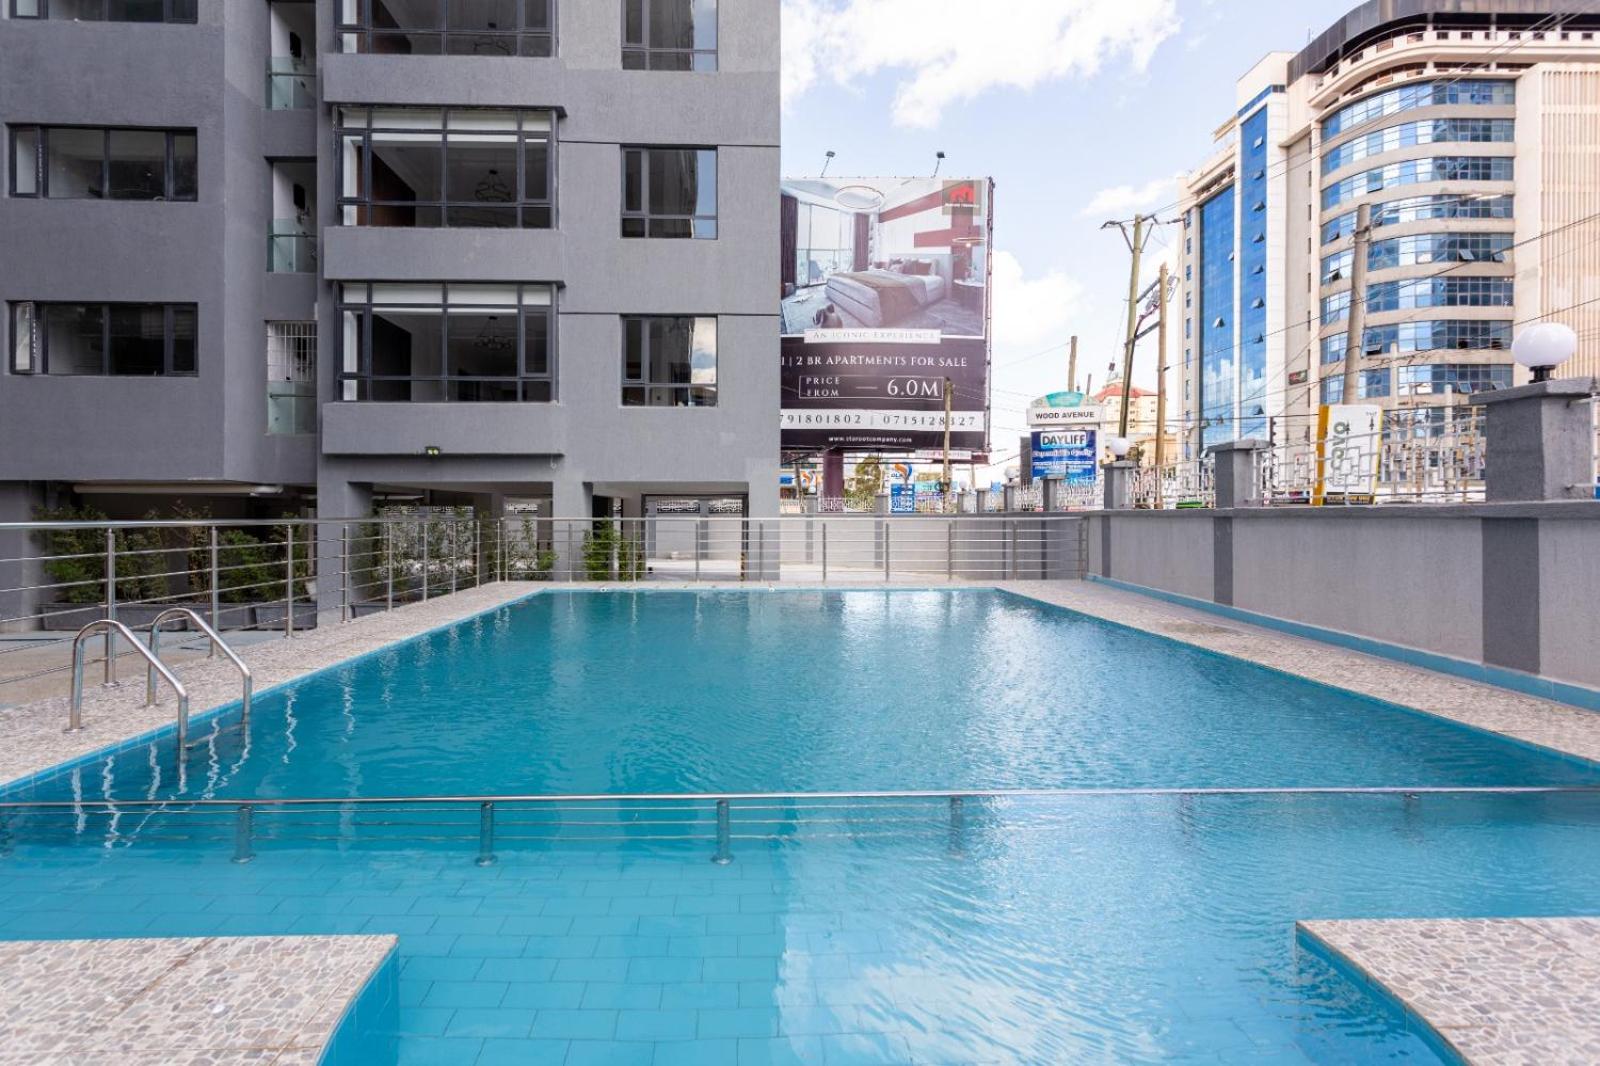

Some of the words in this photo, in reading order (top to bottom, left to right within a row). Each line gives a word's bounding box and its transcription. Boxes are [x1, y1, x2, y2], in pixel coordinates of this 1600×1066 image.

[796, 356, 803, 366] 2
[807, 356, 822, 366] BR
[825, 356, 906, 367] APARTMENTS
[911, 357, 935, 367] FOR
[938, 357, 968, 368] SALE
[805, 377, 841, 385] PRICE
[806, 388, 840, 397] FROM
[887, 379, 939, 397] 6.0M
[1043, 434, 1085, 445] DAYLIFF
